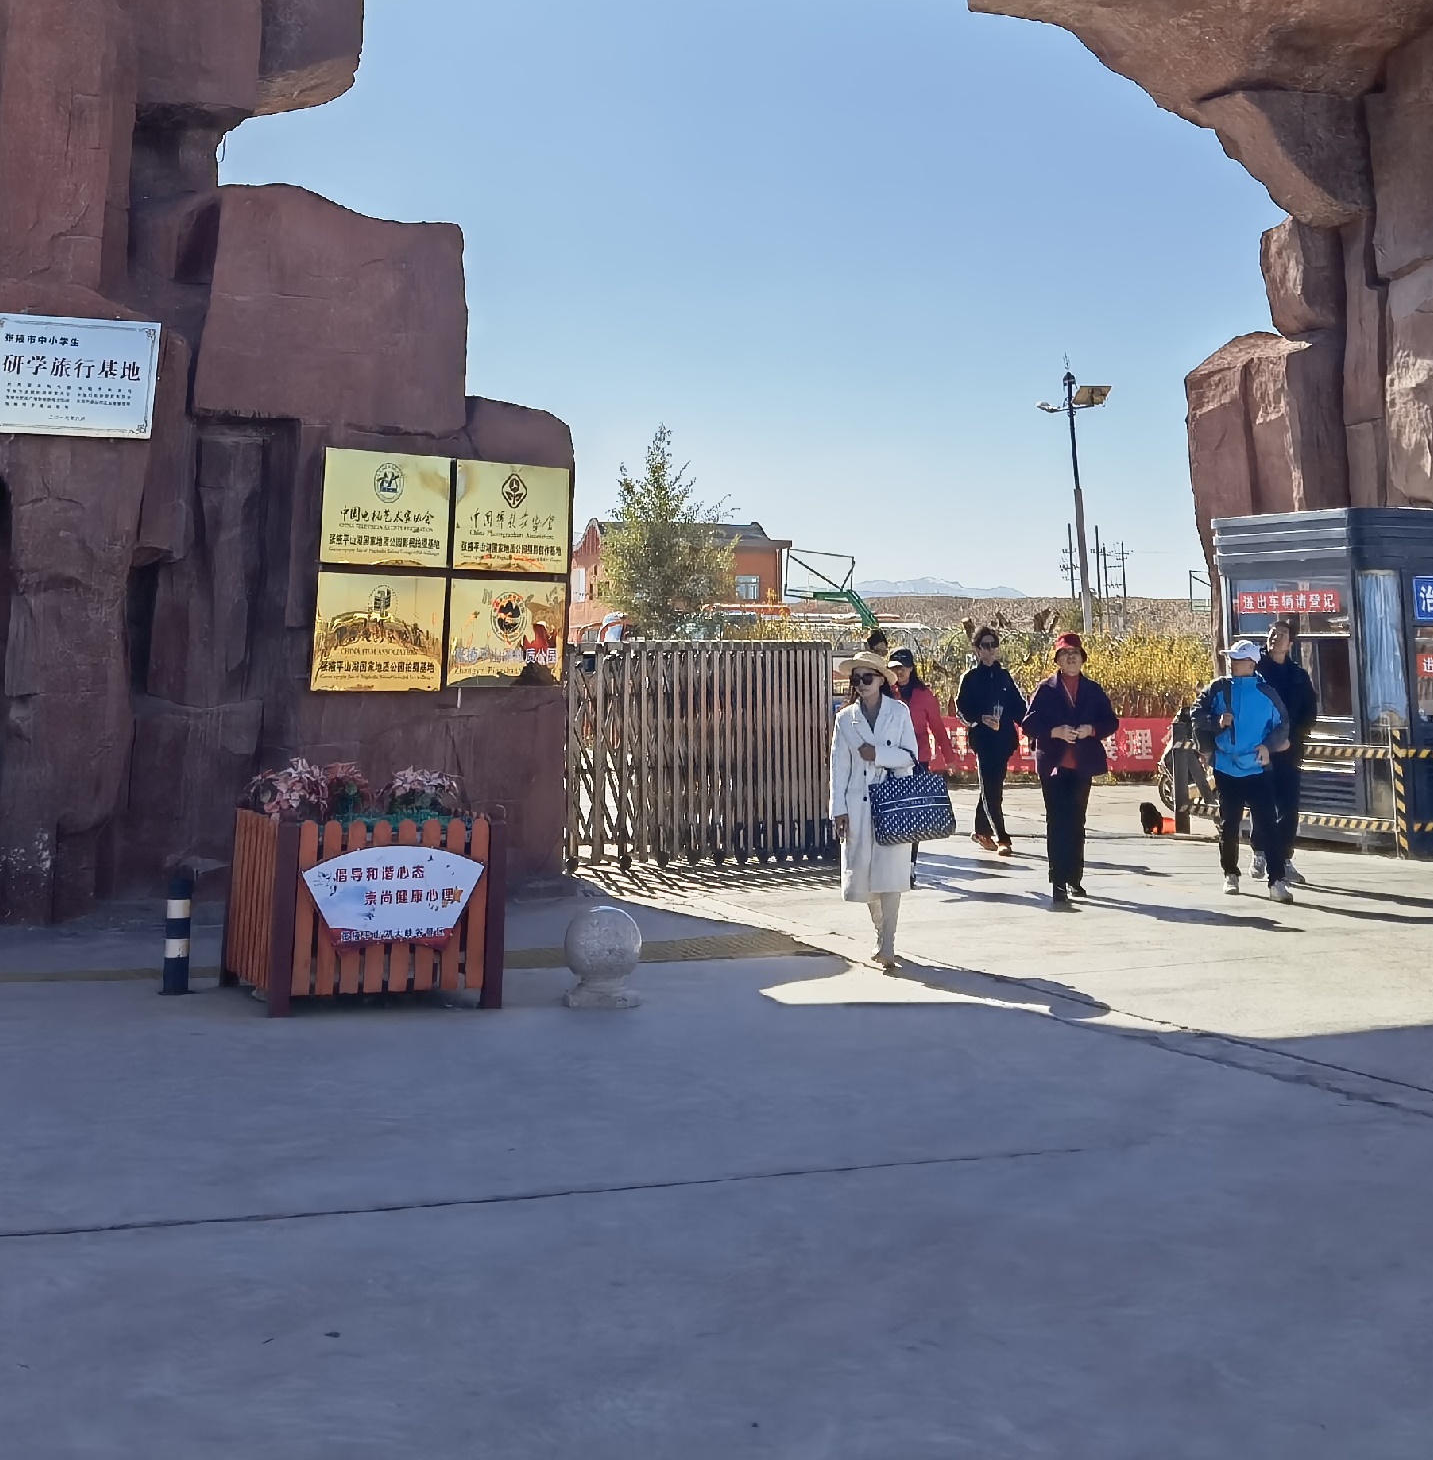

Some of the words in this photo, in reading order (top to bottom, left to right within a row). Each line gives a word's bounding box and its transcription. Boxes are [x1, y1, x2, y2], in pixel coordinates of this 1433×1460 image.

[2, 354, 141, 382] 研学旅行基地
[1242, 593, 1336, 610] 进出车辆请登记
[336, 865, 425, 882] 倡导和谐心态
[364, 888, 454, 905] 崇尚健康心理
